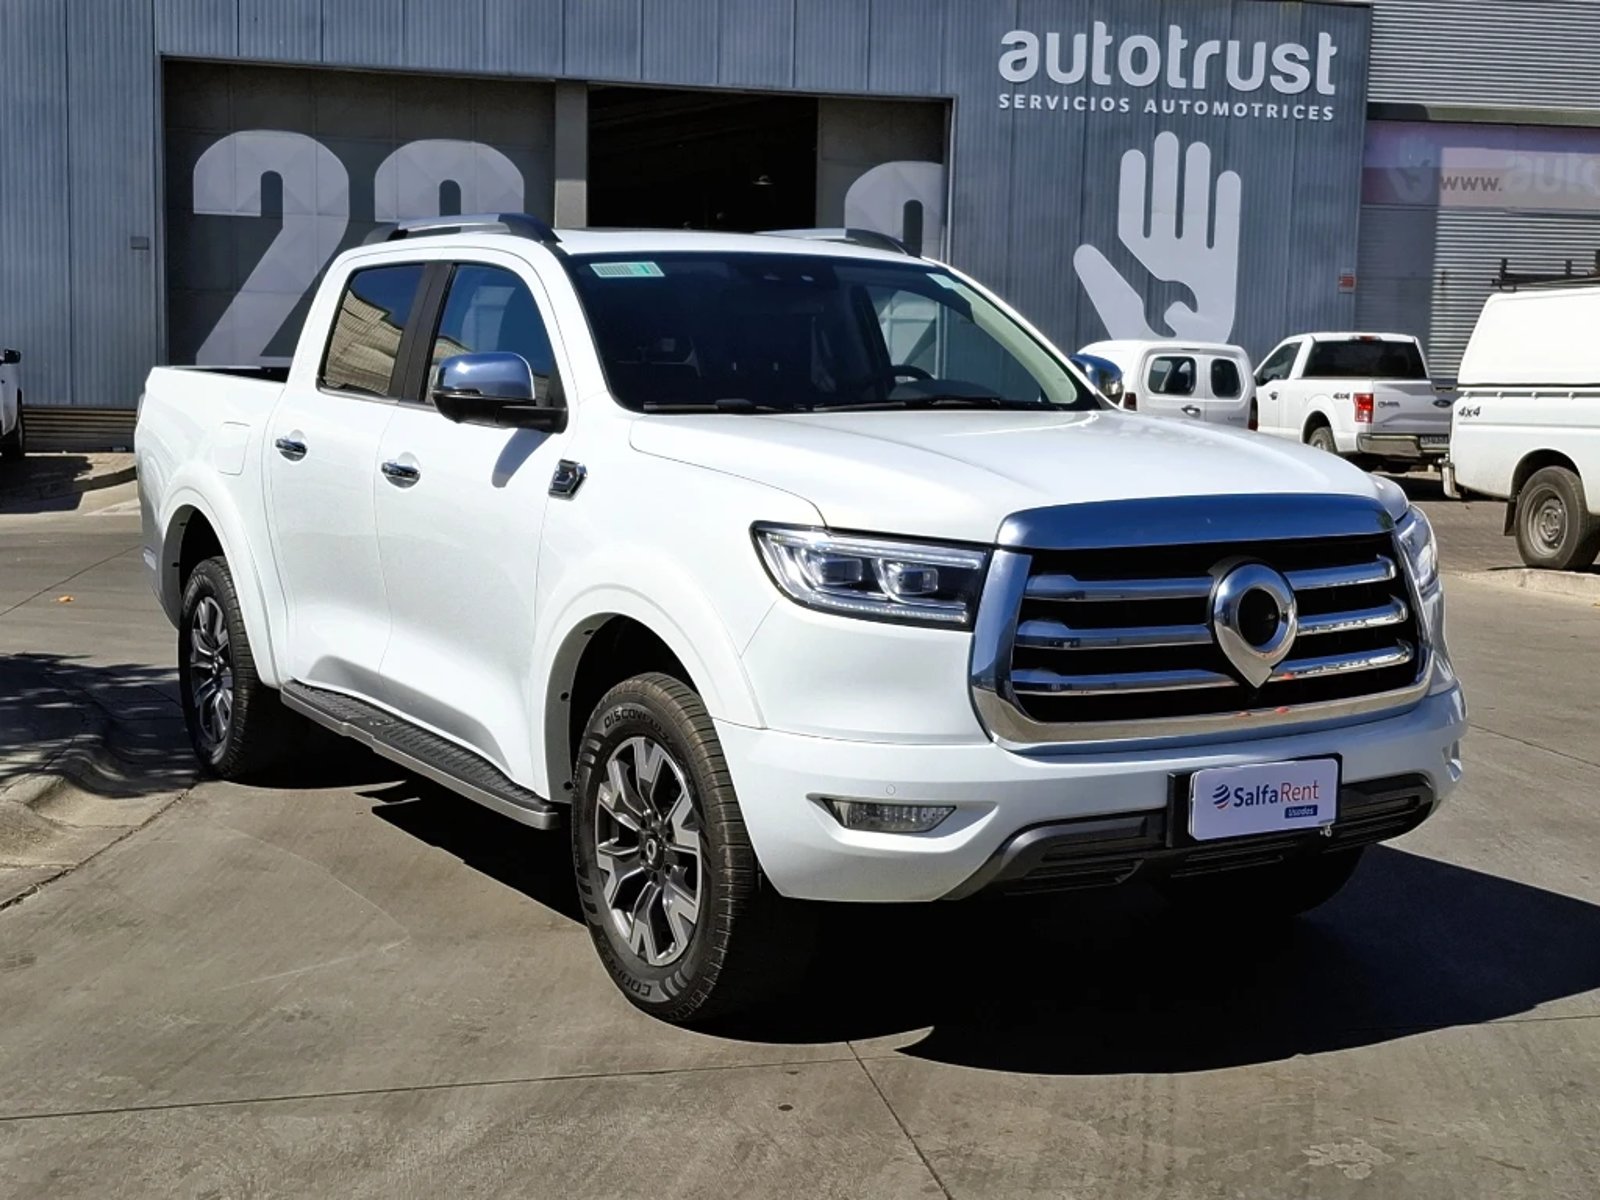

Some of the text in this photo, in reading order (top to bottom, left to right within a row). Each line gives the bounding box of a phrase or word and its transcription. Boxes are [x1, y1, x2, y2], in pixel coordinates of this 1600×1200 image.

[998, 21, 1337, 95] autotrust
[999, 93, 1334, 121] SERVICIOS AUTOMOTRICES
[1458, 406, 1481, 418] 4x4
[1233, 780, 1320, 808] SalfaRent
